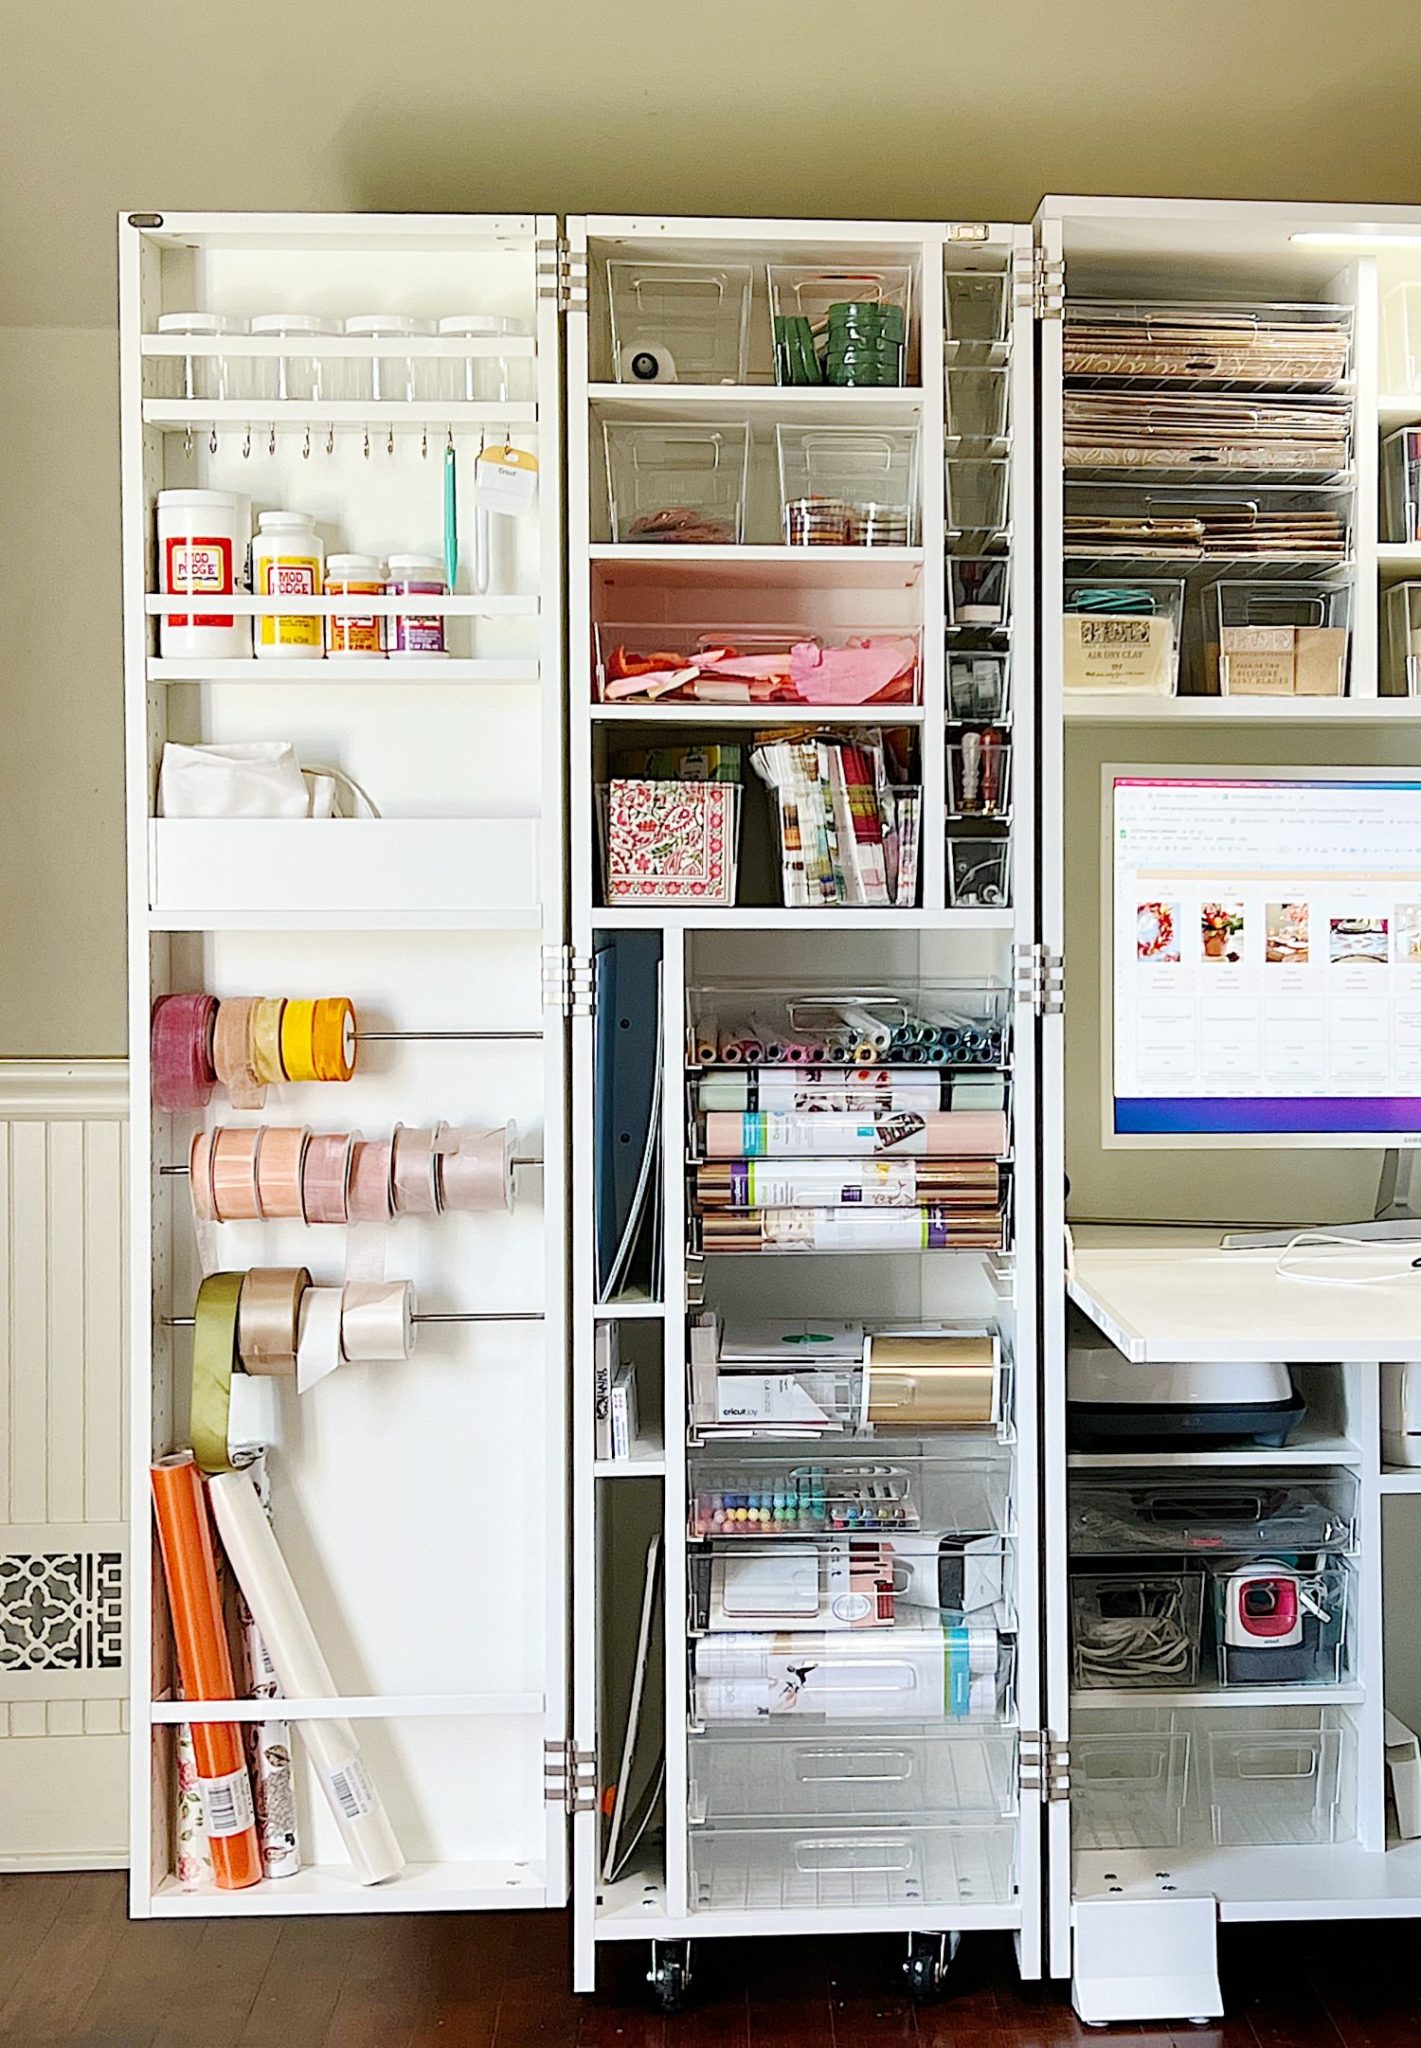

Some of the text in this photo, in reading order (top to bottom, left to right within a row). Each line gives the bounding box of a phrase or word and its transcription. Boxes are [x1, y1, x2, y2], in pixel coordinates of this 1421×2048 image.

[278, 571, 304, 583] MOD
[1088, 651, 1143, 660] AIR DRY CLAY
[723, 1408, 746, 1416] cricut
